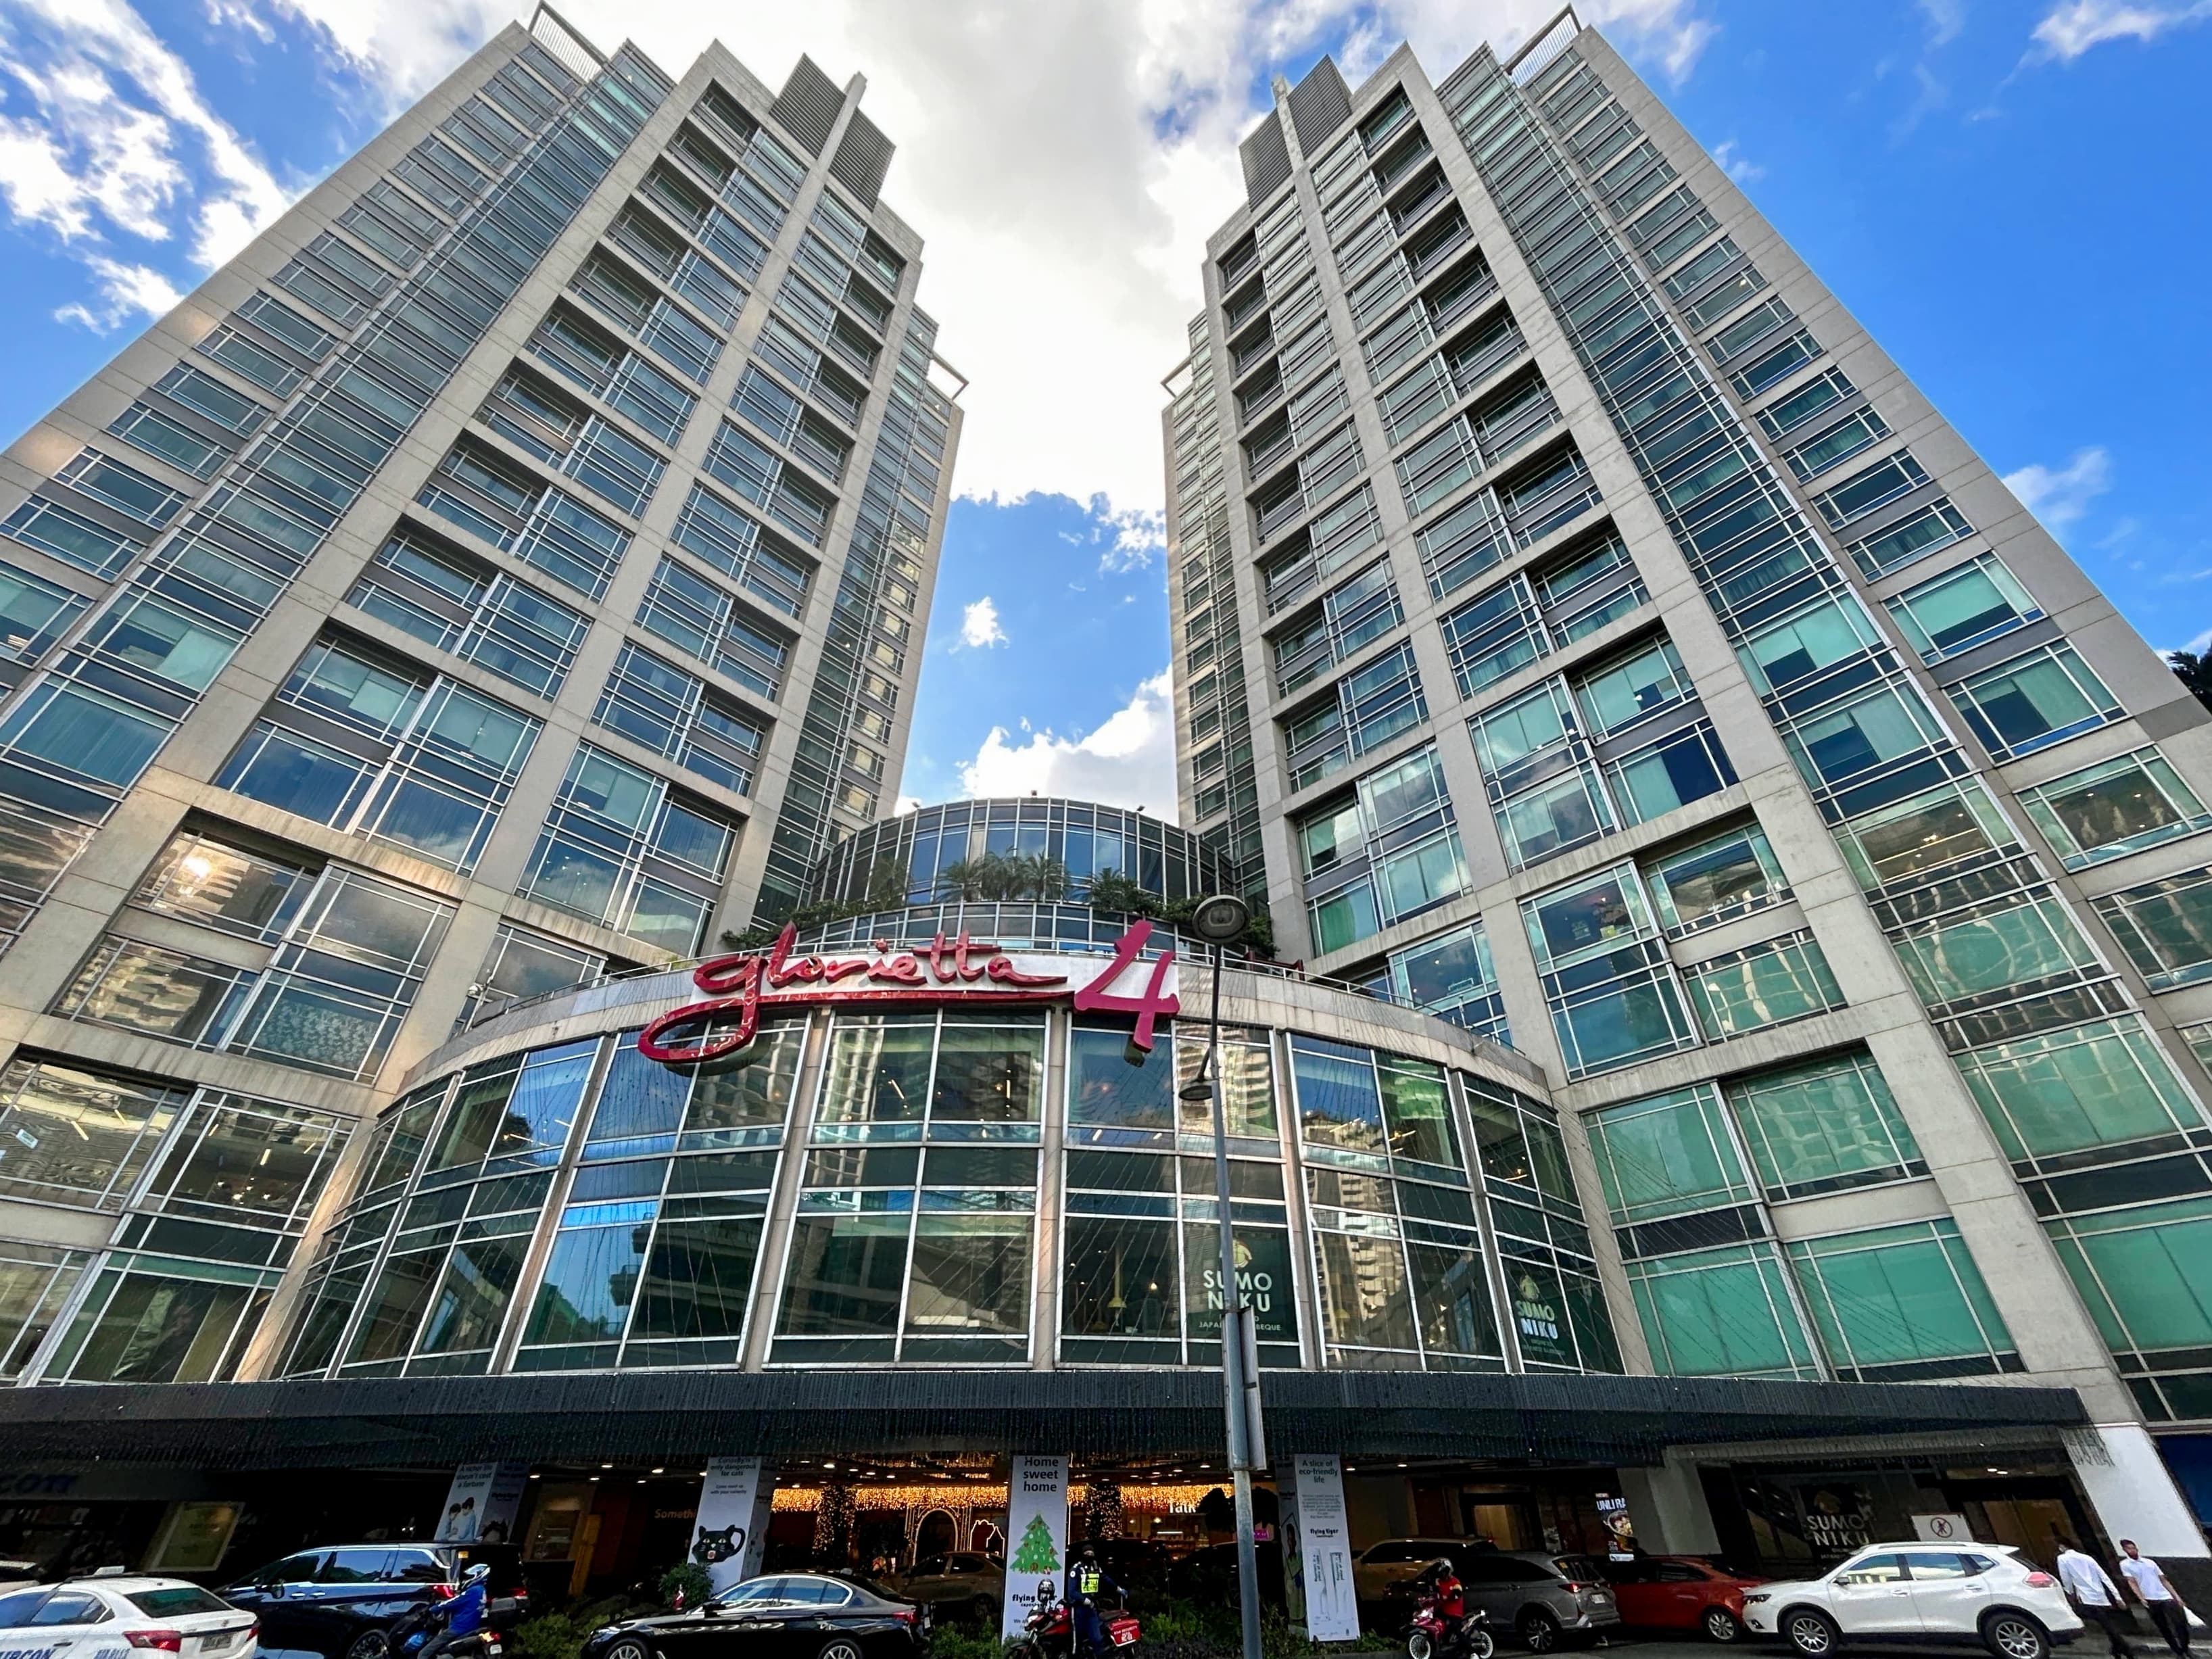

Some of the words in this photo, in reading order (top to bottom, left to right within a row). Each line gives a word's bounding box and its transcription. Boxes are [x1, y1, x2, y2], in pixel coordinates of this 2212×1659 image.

[638, 921, 1074, 1063] glorietta
[1074, 919, 1180, 1053] 4
[1207, 1291, 1271, 1312] NKU
[1515, 1300, 1555, 1322] SUMO
[1520, 1318, 1558, 1339] NIKU
[1024, 1456, 1059, 1467] Home
[1023, 1470, 1059, 1479] sweet
[1299, 1468, 1338, 1476] eco-friendly
[1024, 1481, 1057, 1492] home
[1806, 1514, 1865, 1531] SUMO
[1813, 1531, 1870, 1546] NIKU
[1012, 1593, 1036, 1603] flying
